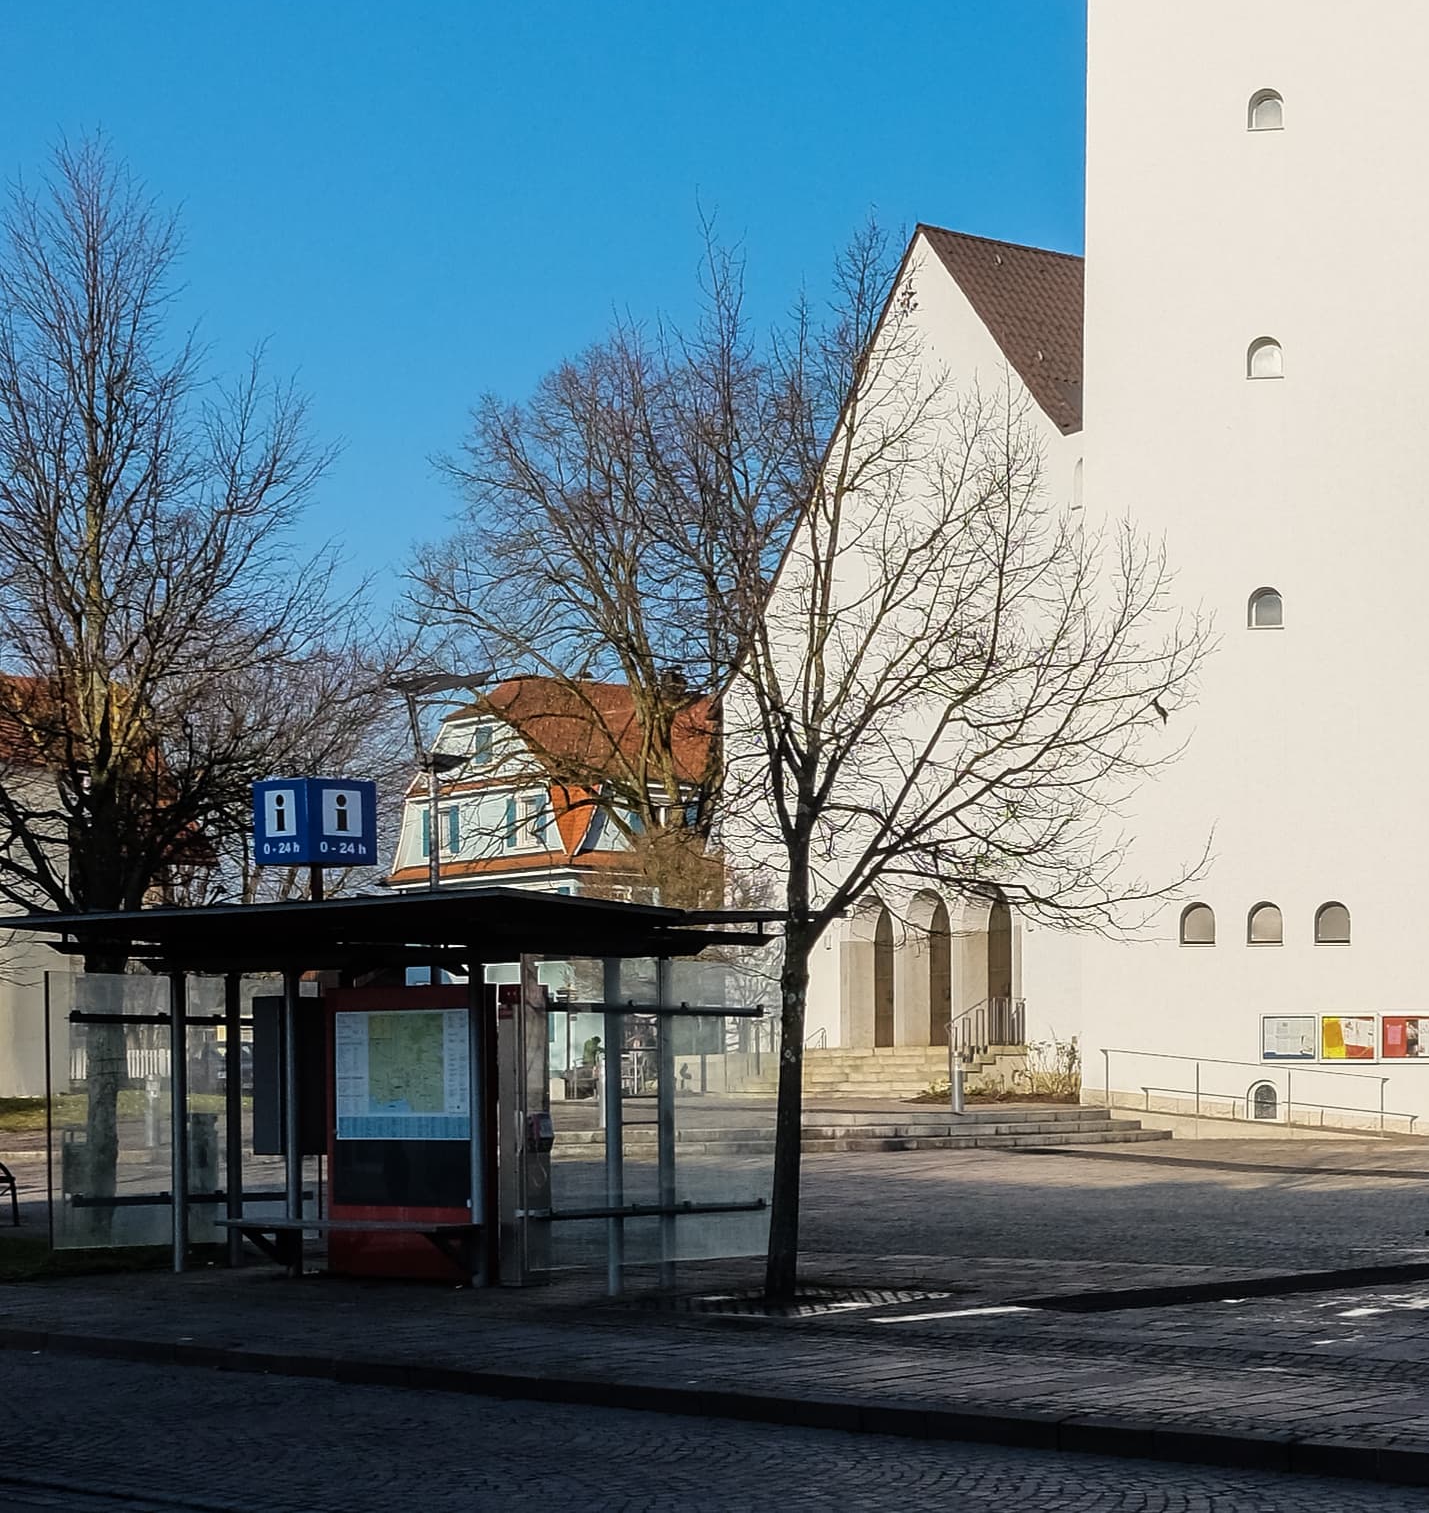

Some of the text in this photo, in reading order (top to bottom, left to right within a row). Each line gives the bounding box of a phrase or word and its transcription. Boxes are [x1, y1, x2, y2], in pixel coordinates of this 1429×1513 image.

[263, 842, 271, 855] 0
[278, 842, 291, 854] 24
[293, 841, 300, 853] h
[319, 841, 328, 853] 0
[339, 842, 355, 854] 24
[358, 843, 367, 855] h
